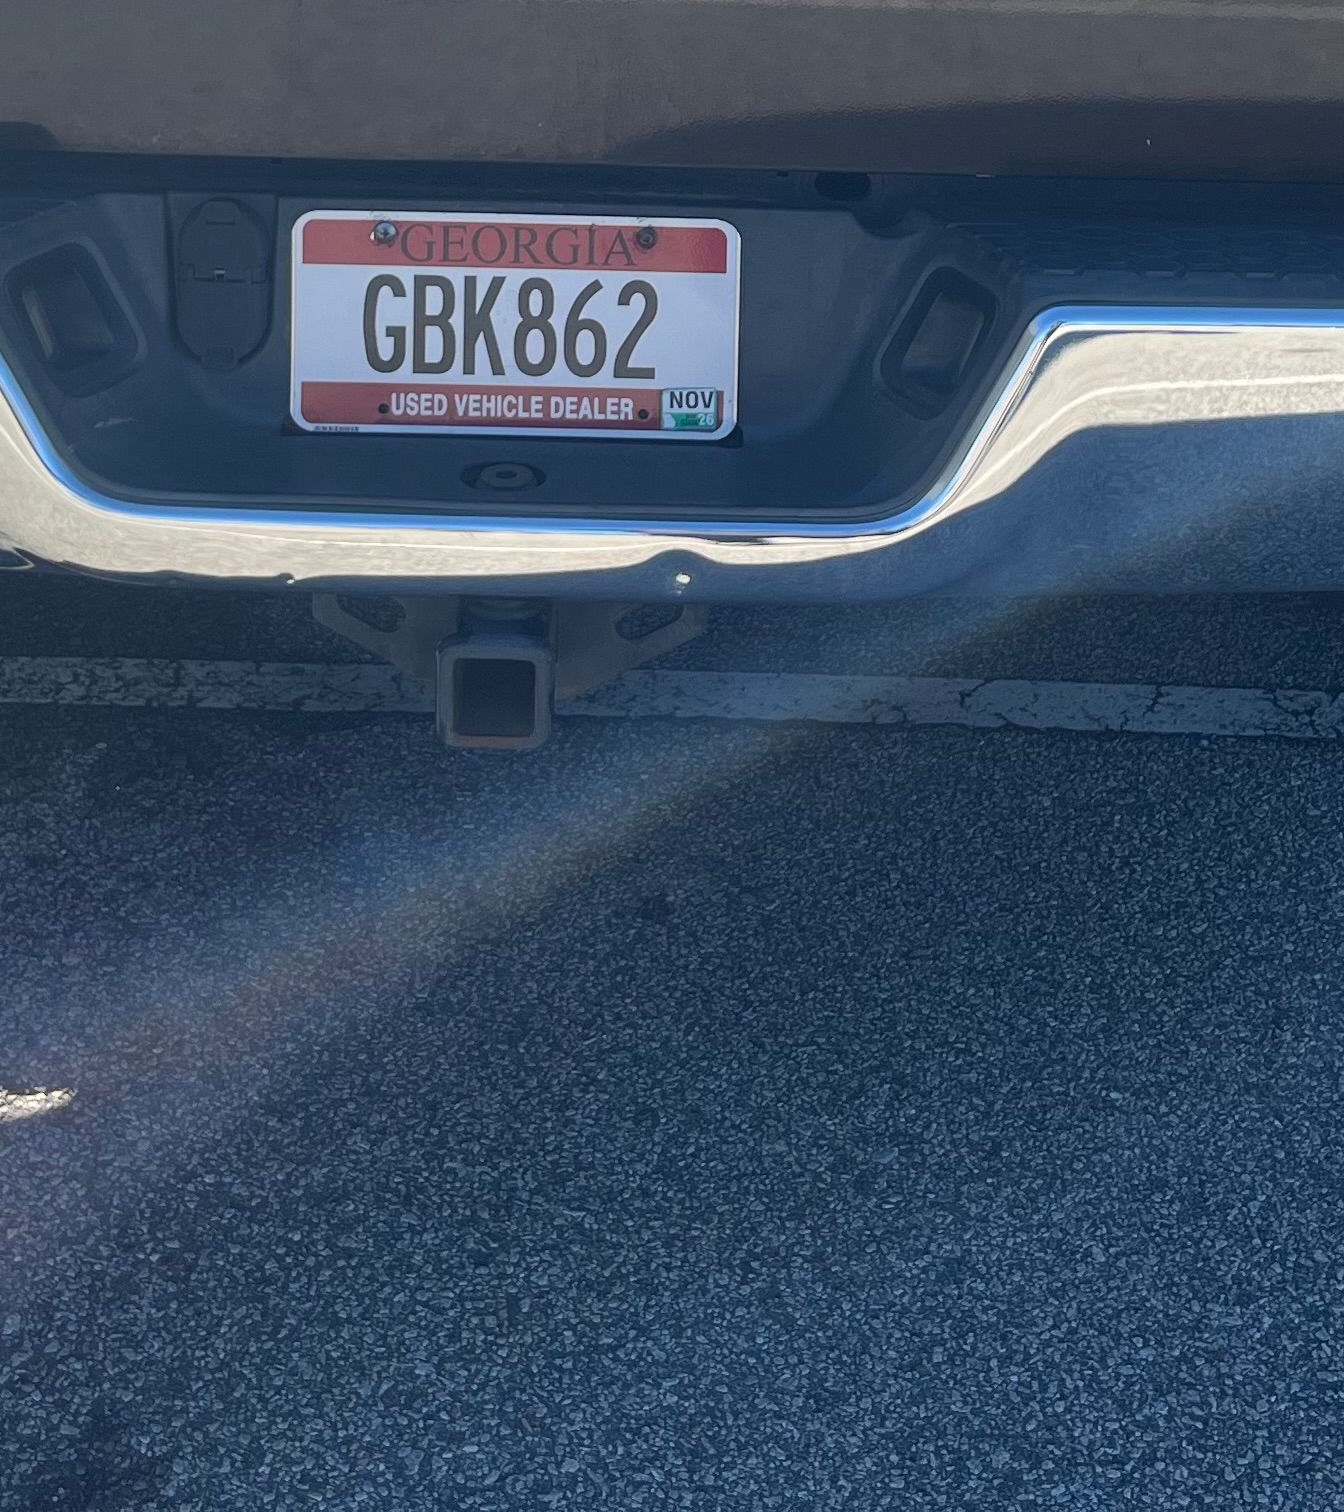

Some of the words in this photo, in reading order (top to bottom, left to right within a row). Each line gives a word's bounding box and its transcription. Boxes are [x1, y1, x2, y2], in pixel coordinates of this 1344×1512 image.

[400, 222, 639, 267] GEORGIA
[362, 273, 658, 380] GBK862
[390, 392, 448, 418] USED
[455, 393, 544, 419] VEHICLE
[550, 395, 635, 421] DEALER
[669, 391, 714, 409] NOV
